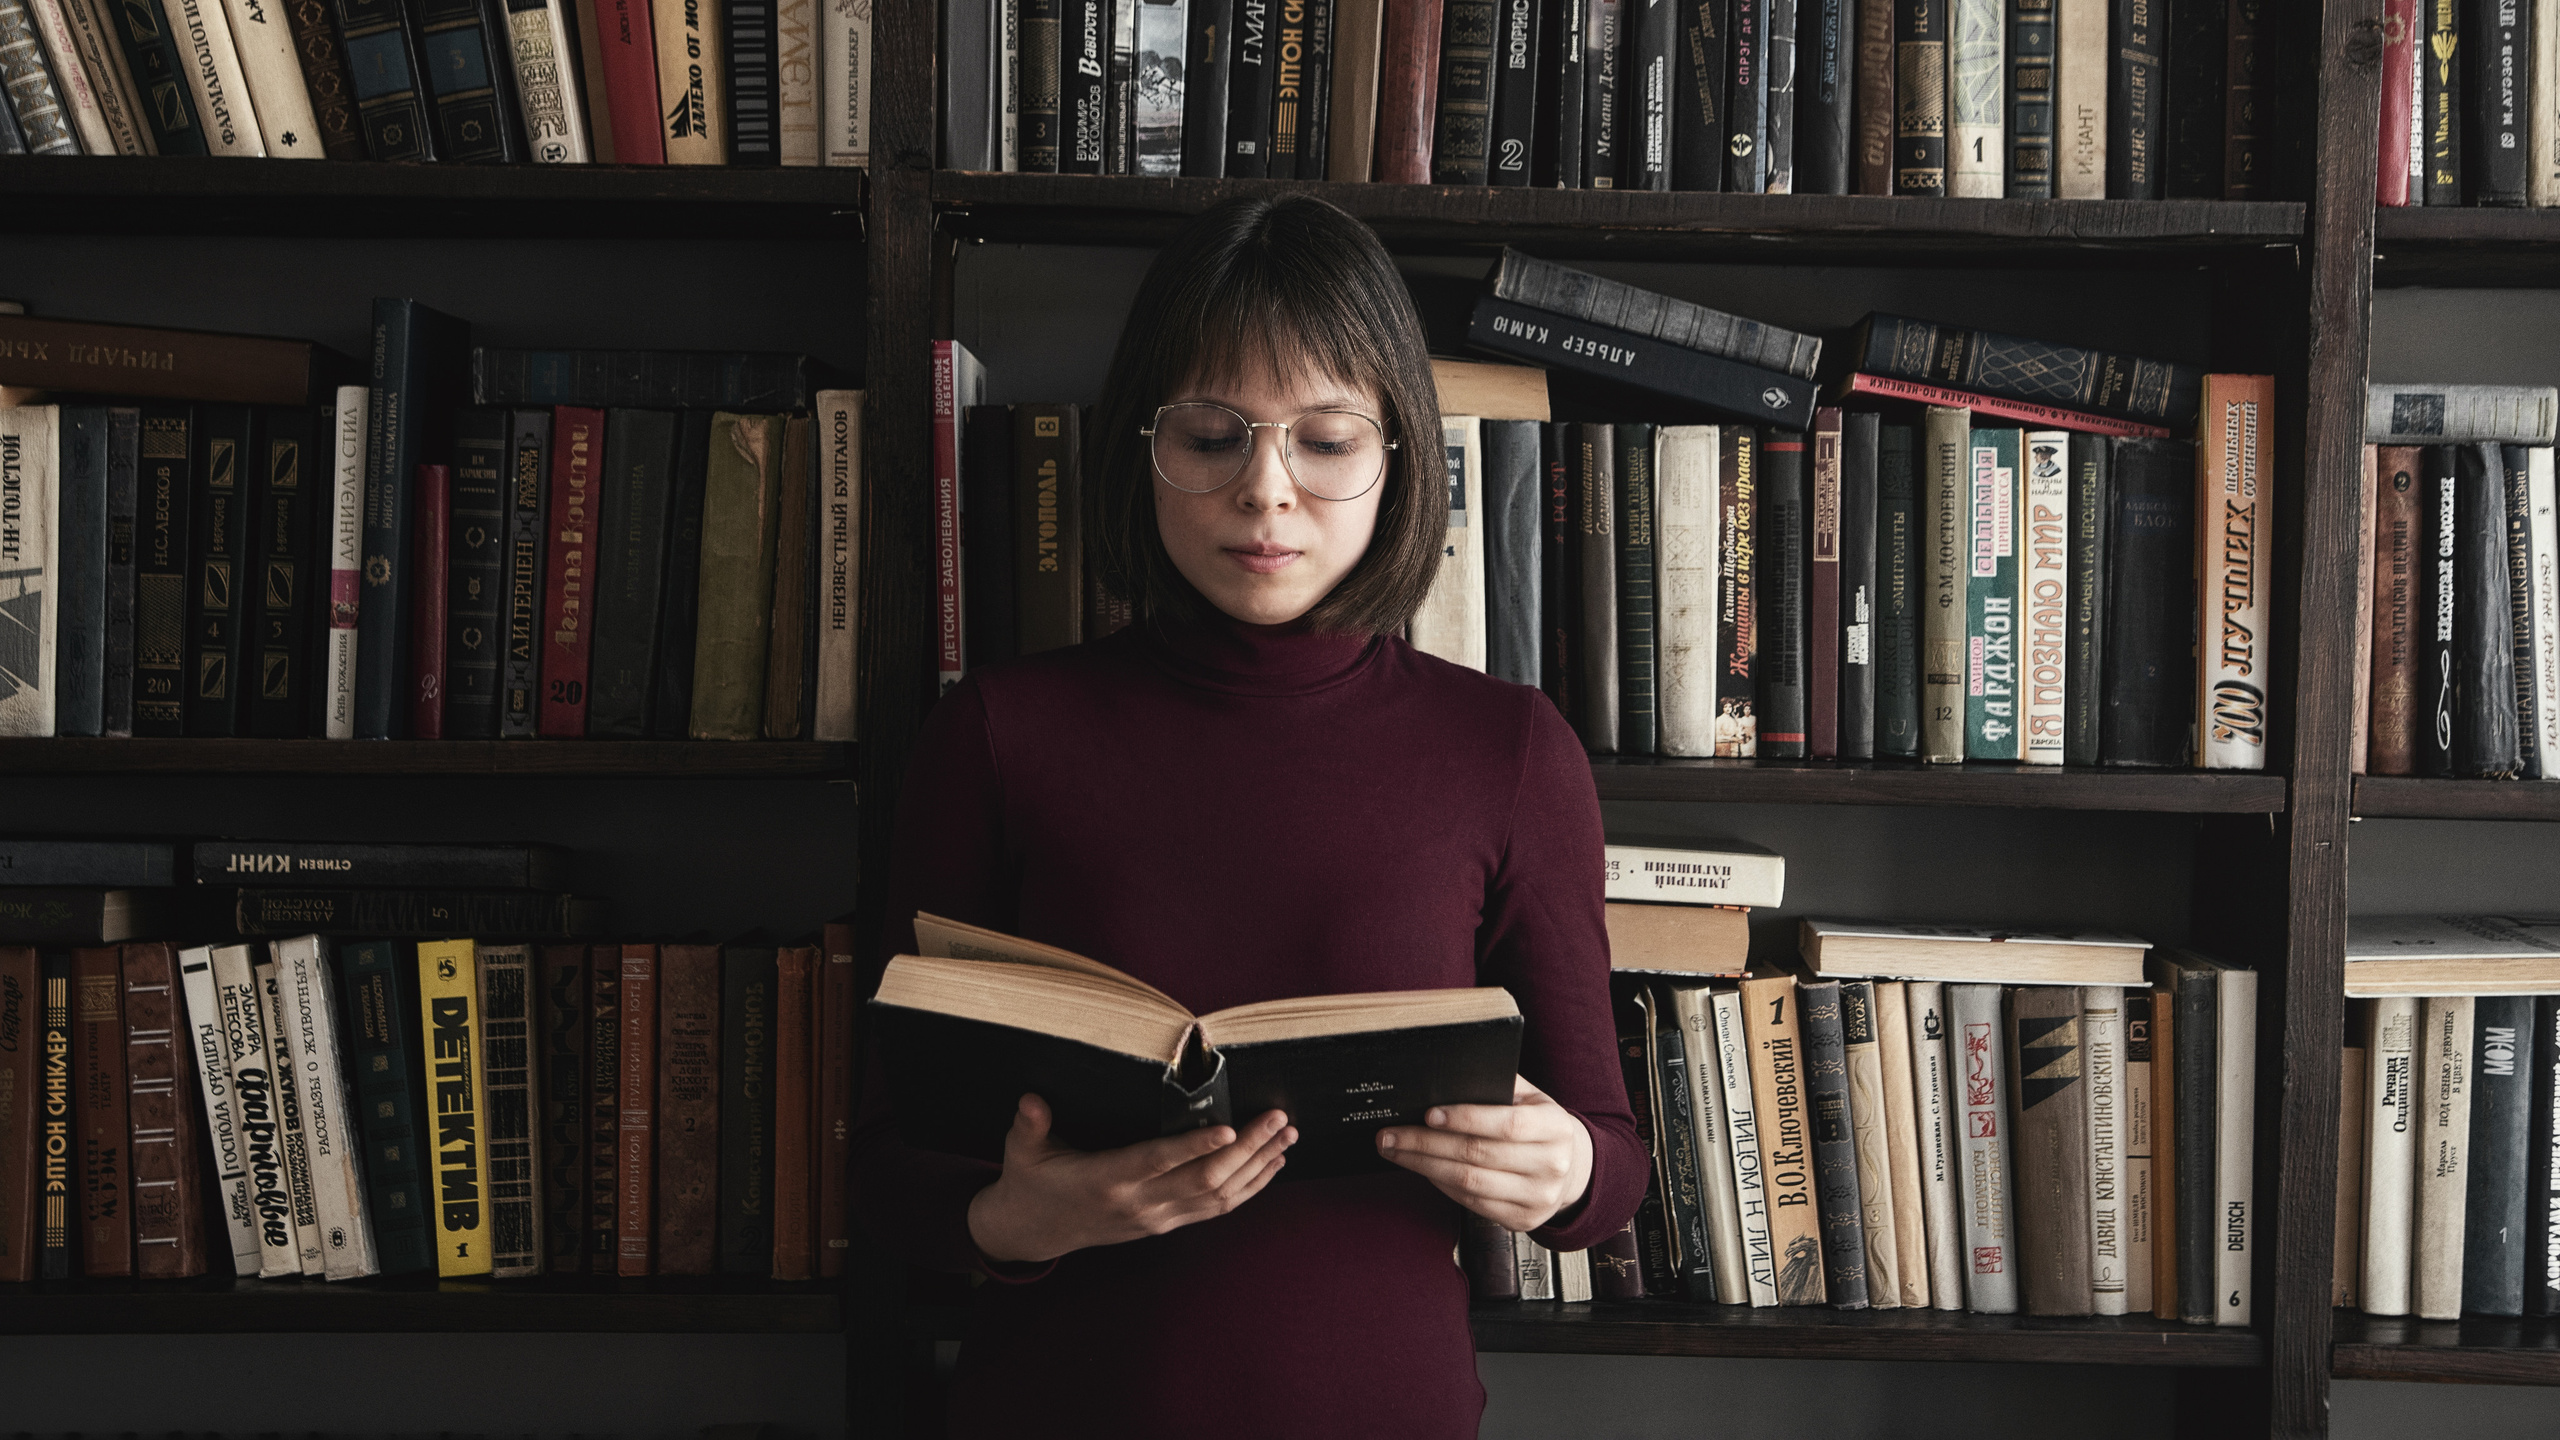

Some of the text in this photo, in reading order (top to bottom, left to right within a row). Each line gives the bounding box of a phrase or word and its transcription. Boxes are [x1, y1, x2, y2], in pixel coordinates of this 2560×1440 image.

[149, 52, 159, 68] 4
[451, 49, 466, 70] 3
[1203, 24, 1217, 63] 1
[1278, 28, 1301, 99] ЭПТОН
[1739, 18, 1752, 86] СПРЭГ де
[2133, 31, 2146, 46] К
[688, 35, 708, 139] ДАЛЕКО ОТ
[1596, 14, 1617, 158] Мелани Джексон
[1035, 122, 1046, 138] 3
[1076, 98, 1088, 162] ВЛАДИМИР
[1087, 84, 1101, 162] БОГОМОЛОВ
[1498, 139, 1525, 172] 2
[1972, 136, 1986, 163] 1
[2131, 129, 2147, 184] ВИЛИС
[67, 341, 174, 374] РИЧАРД
[1491, 314, 1637, 367] АЛЬБЕР КАМЮ
[934, 357, 952, 415] ЗДОРОВЬЕ РЕБЕНКА
[1868, 376, 1982, 408] ЧИТАЕМ ПО-НЕМЕЦКИ
[339, 407, 359, 562] ДАНИЭЛА СТИЛ
[382, 391, 398, 529] ЮНОГО МАТЕМАТИКА
[1549, 461, 1568, 524] РОСТ
[1579, 441, 1593, 534] Константин
[2513, 469, 2529, 518] жизни
[154, 465, 171, 567] Н.С.ЛЕСКОВ
[553, 423, 592, 653] Агата Кристи
[831, 410, 849, 631] НЕИЗВЕСТНЫЙ БУЛГАКОВ
[1037, 458, 1059, 572] Э.ТОПОЛЬ
[1975, 449, 2012, 573] СЕДЬМАЯ ПРИНЦЕССА
[940, 477, 957, 662] ДЕТСКИЕ ЗАБОЛЕВАНИЯ
[1723, 505, 1739, 623] Галина Щербакова
[1729, 436, 1753, 679] Женщины в игре без правил
[2211, 400, 2263, 746] 700 ЛУЧШИХ ШКОЛЬНЫХ СОЧИНЕНИЙ
[2437, 476, 2456, 642] НИКОЛАЙ САМОХИН
[2508, 530, 2532, 649] ПРАШКЕВИЧ
[206, 620, 220, 638] 4
[512, 539, 534, 659] А.И.ГЕРЦЕН
[2030, 504, 2063, 737] Я ПОЗНАЮ МИР
[335, 632, 350, 725] День рождения
[549, 680, 583, 705] 20
[1970, 638, 1983, 695] ЭЛИНОР
[1981, 595, 2015, 742] ФАРДЖОН
[1934, 707, 1953, 722] 12
[225, 851, 352, 876] СТИВЕН КИНГ
[1643, 861, 1732, 890] ДМИТРИЙ НАГИШКИН
[260, 896, 336, 923] АЛЕКСЕЙ ТОЛСТОЙ
[221, 982, 261, 1063] ЭЛЬМИРА НЕТЕСОВА
[360, 973, 389, 1044] ИСТОРИКИ АНТИЧНОСТИ
[1770, 995, 1786, 1025] 1
[1854, 997, 1868, 1038] БЛОК
[292, 958, 332, 1156] РАССКАЗЫ О ЖИВОТНЫХ
[628, 982, 643, 1107] ПУШКИН НА ЮГЕ
[679, 1067, 702, 1075] ДОН
[1718, 1005, 1737, 1089] Юлиан Семенов
[2483, 1026, 2516, 1075] МОЭМ
[45, 1029, 67, 1191] ЭПТОН СИНКЛЕР
[198, 1023, 238, 1172] ГОСПОДА ОФИЦЕРЫ
[672, 1076, 710, 1086] КИХОТ
[2381, 1057, 2398, 1106] Ричард
[2438, 1061, 2453, 1127] ПОД СЕНЬЮ
[684, 1117, 696, 1133] 2
[1764, 1036, 1808, 1207] В.О.Ключевский
[2088, 1041, 2117, 1258] ДАВИД КОНСТАНТИНОВСКИЙ
[293, 1132, 315, 1226] ВОСПОМИНАНИЯ
[2436, 1139, 2458, 1178] Марсель Пруст
[1731, 1107, 1773, 1287] ЛИЦОМ ЛИЦУ
[2228, 1200, 2245, 1252] DEUTSCH
[2498, 1225, 2508, 1244] 1
[2228, 1290, 2240, 1307] 6
